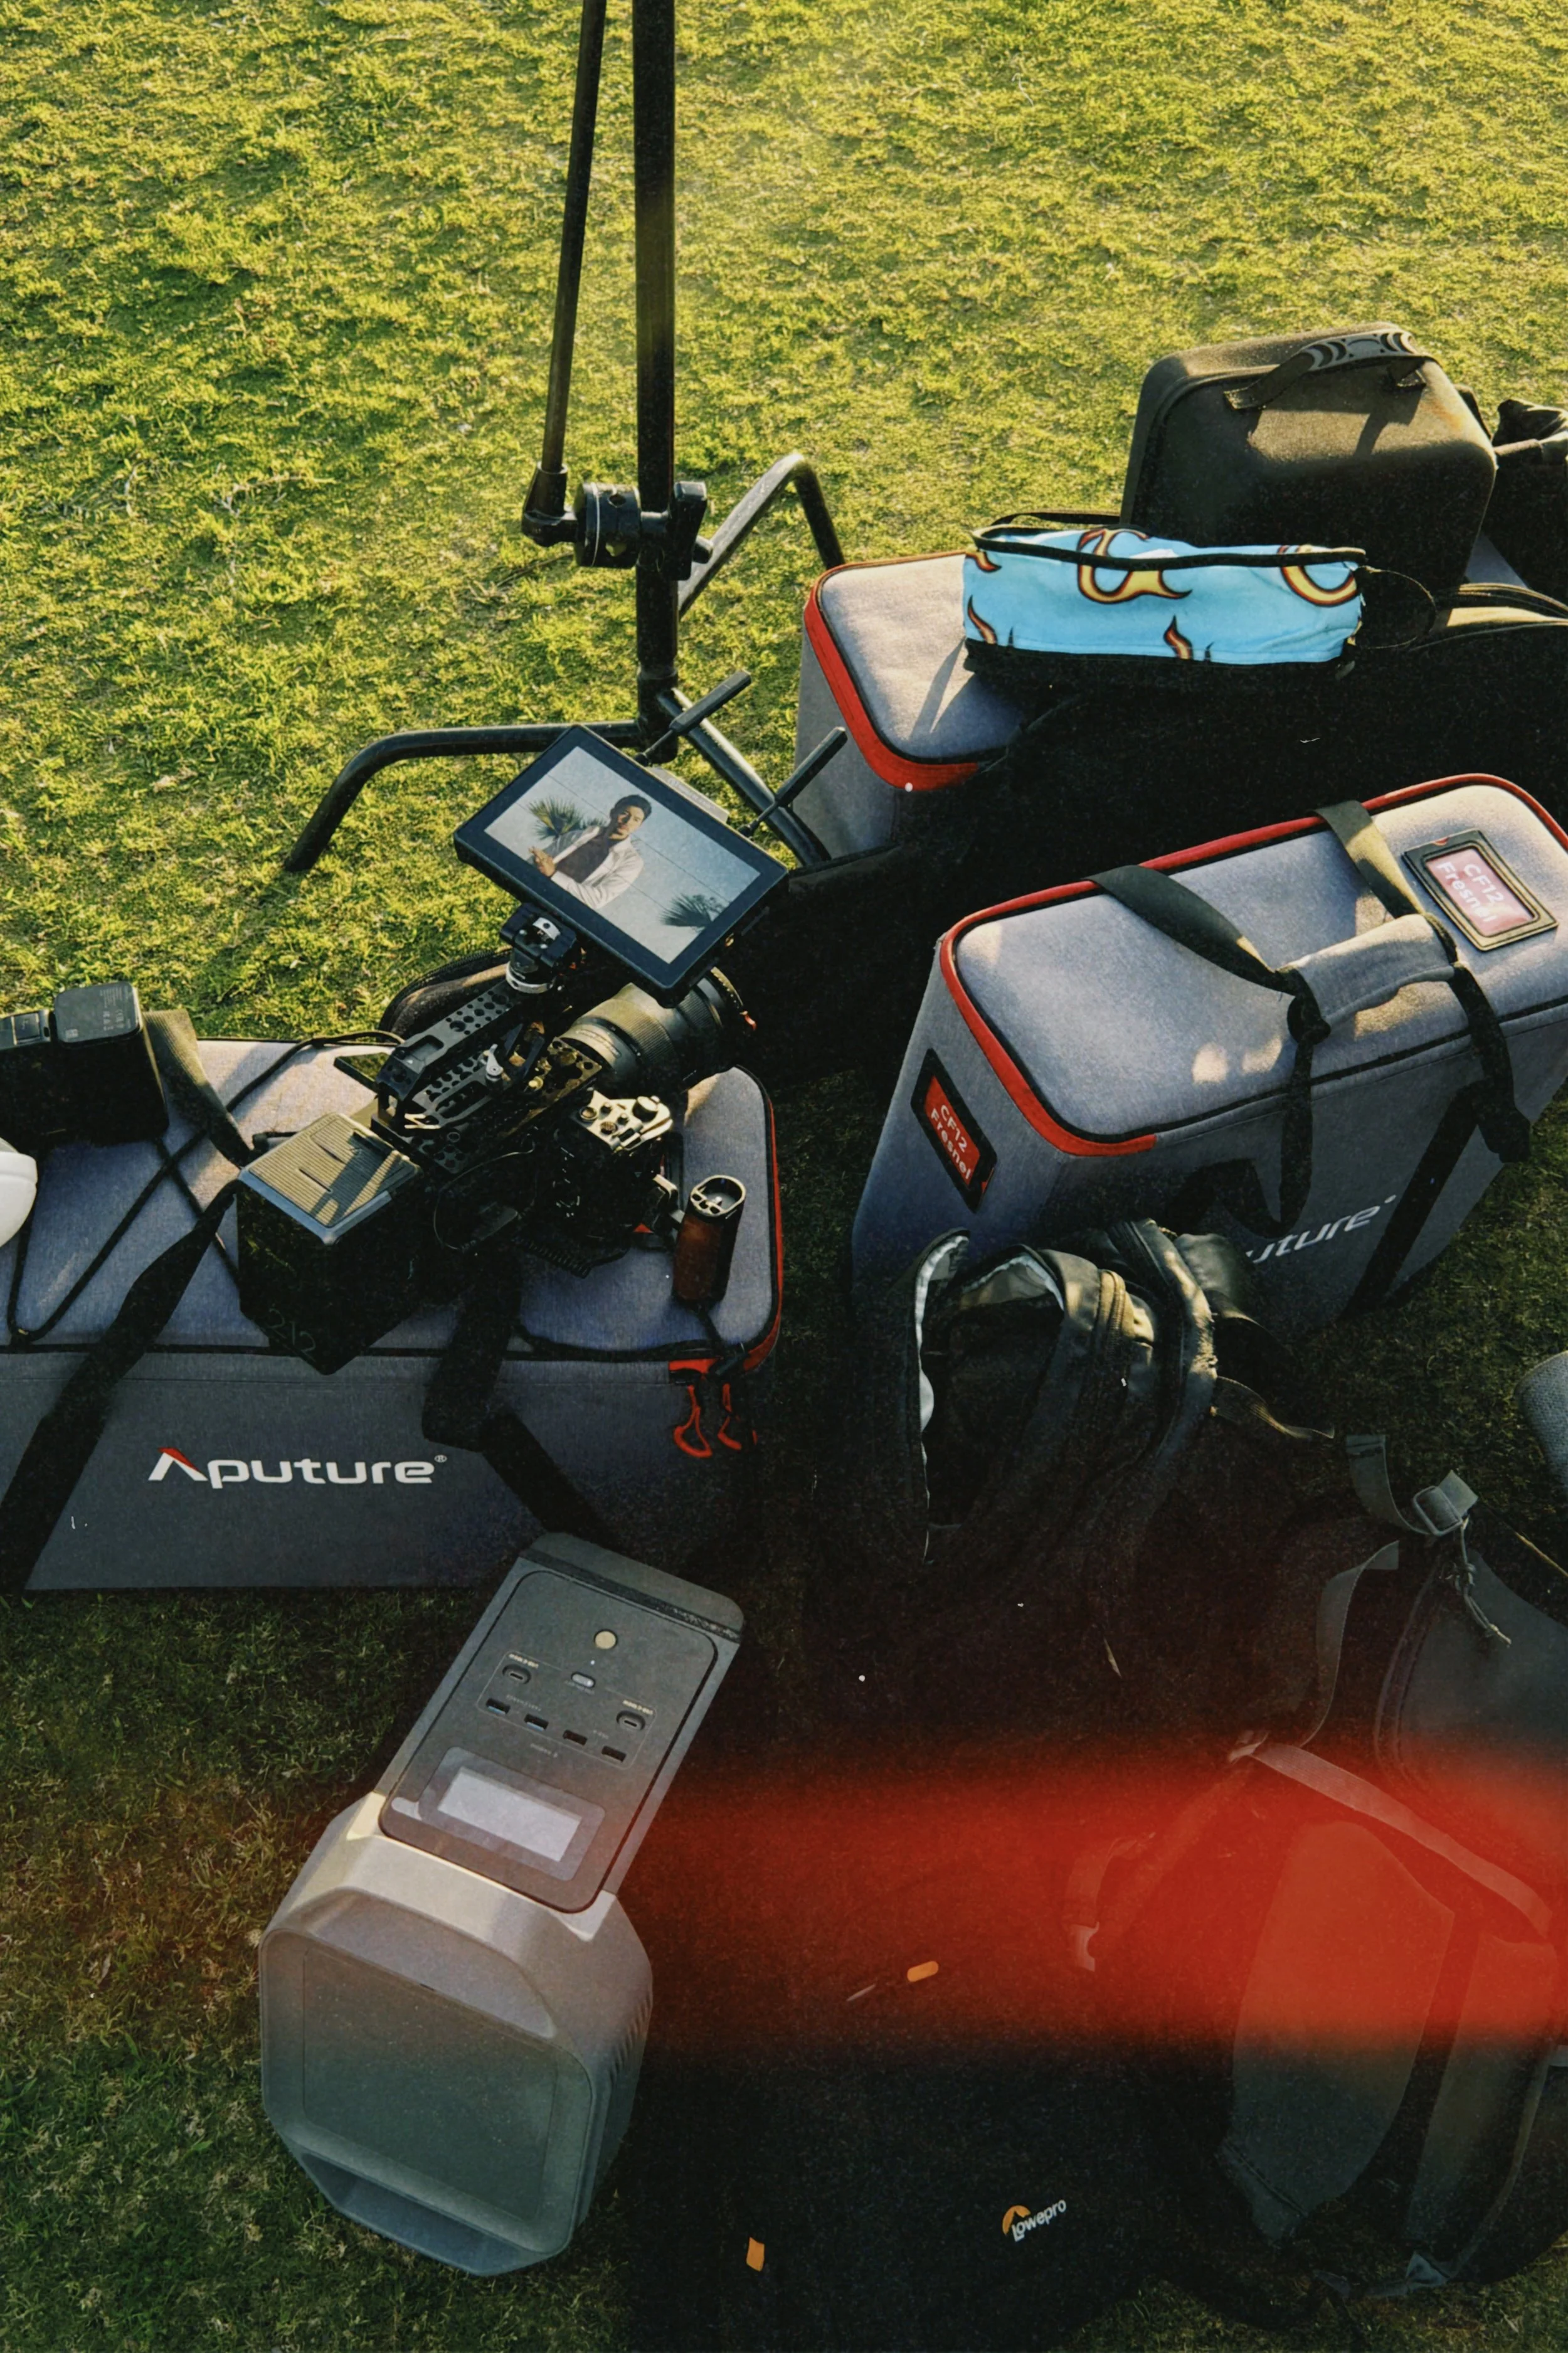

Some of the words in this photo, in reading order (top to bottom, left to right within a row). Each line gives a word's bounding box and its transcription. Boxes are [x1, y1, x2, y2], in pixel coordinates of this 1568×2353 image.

[1436, 862, 1498, 923] Fresnel
[1463, 864, 1505, 904] CF12
[930, 1108, 972, 1179] Fresnel
[940, 1105, 968, 1152] CF12
[1246, 1204, 1381, 1263] uture
[1011, 2199, 1067, 2243] Lowepro
